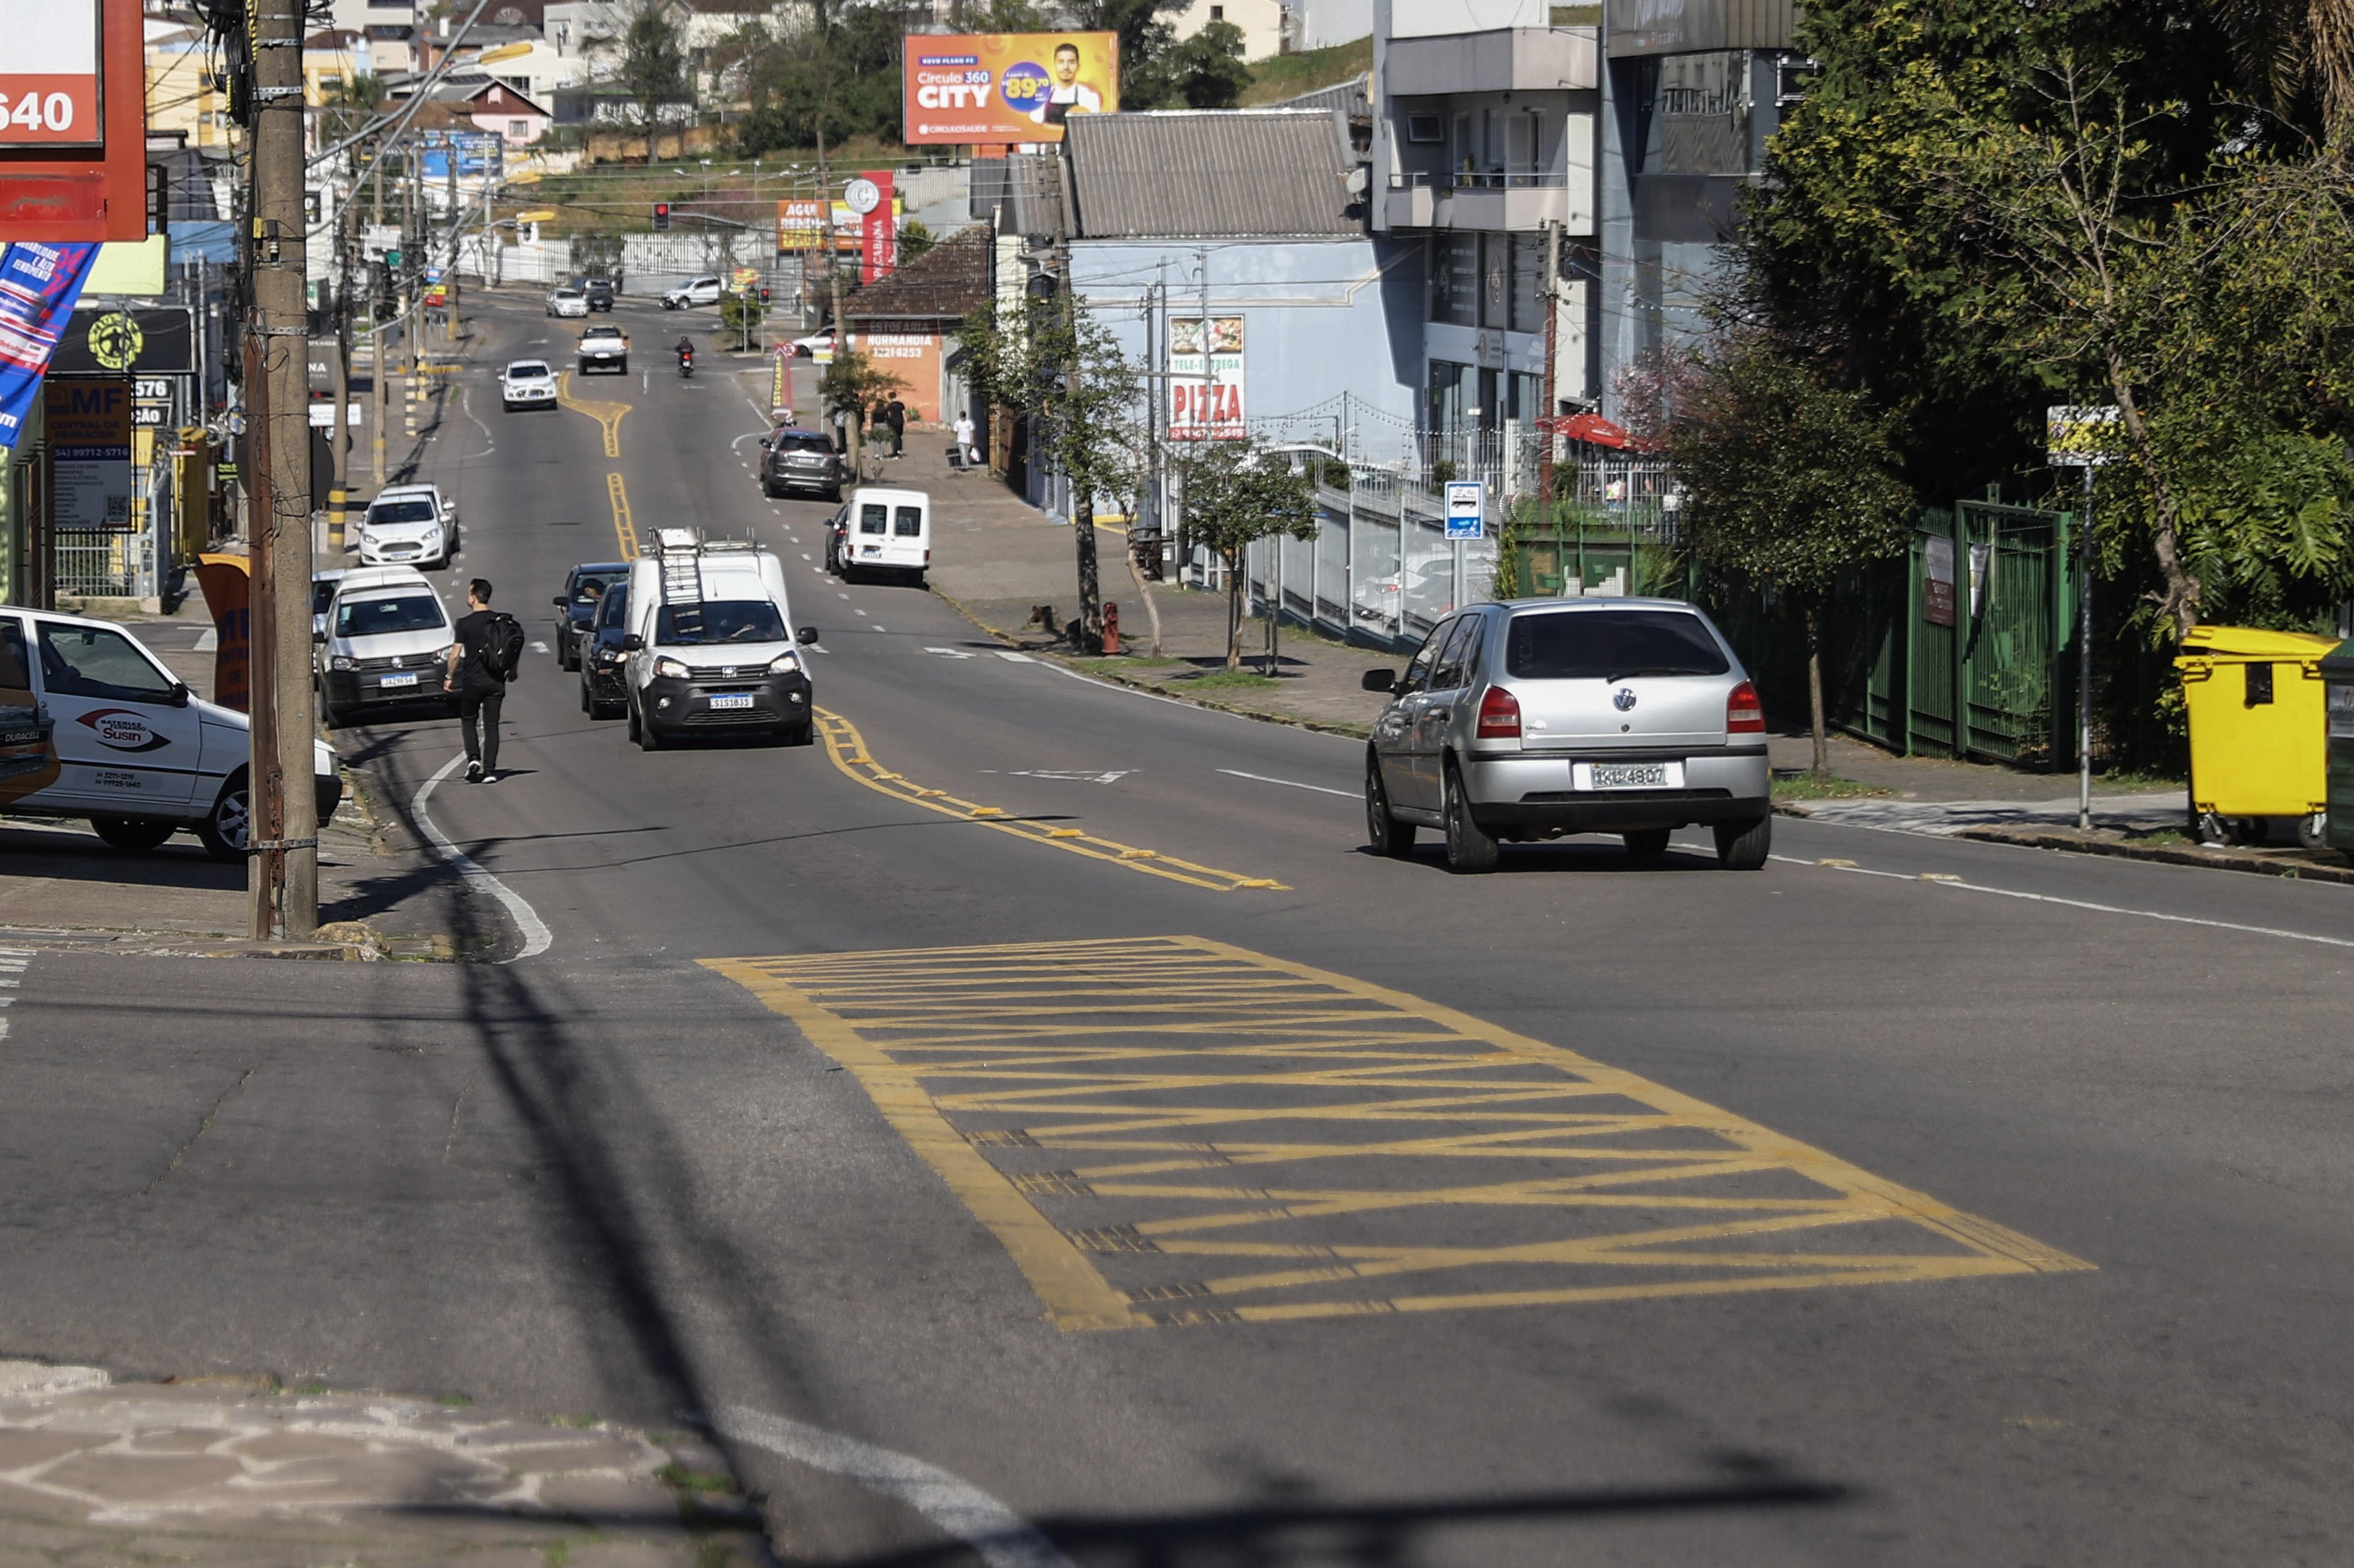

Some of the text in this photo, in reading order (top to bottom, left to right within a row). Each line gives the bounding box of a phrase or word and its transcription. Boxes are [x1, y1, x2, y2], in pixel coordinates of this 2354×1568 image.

[918, 72, 963, 84] Círculo
[964, 72, 989, 83] 360
[917, 85, 992, 108] CITY
[1005, 78, 1037, 99] 89
[12, 258, 52, 282] RENDIMENTO
[32, 256, 56, 274] E ALTO
[867, 335, 933, 346] NORMANDIA
[1174, 359, 1239, 370] TELE-ETREGA
[72, 388, 123, 415] MF
[1174, 384, 1241, 422] PIZZA
[50, 421, 100, 430] CENTRAL
[5, 731, 39, 743] DURACELL
[102, 727, 142, 742] Susin
